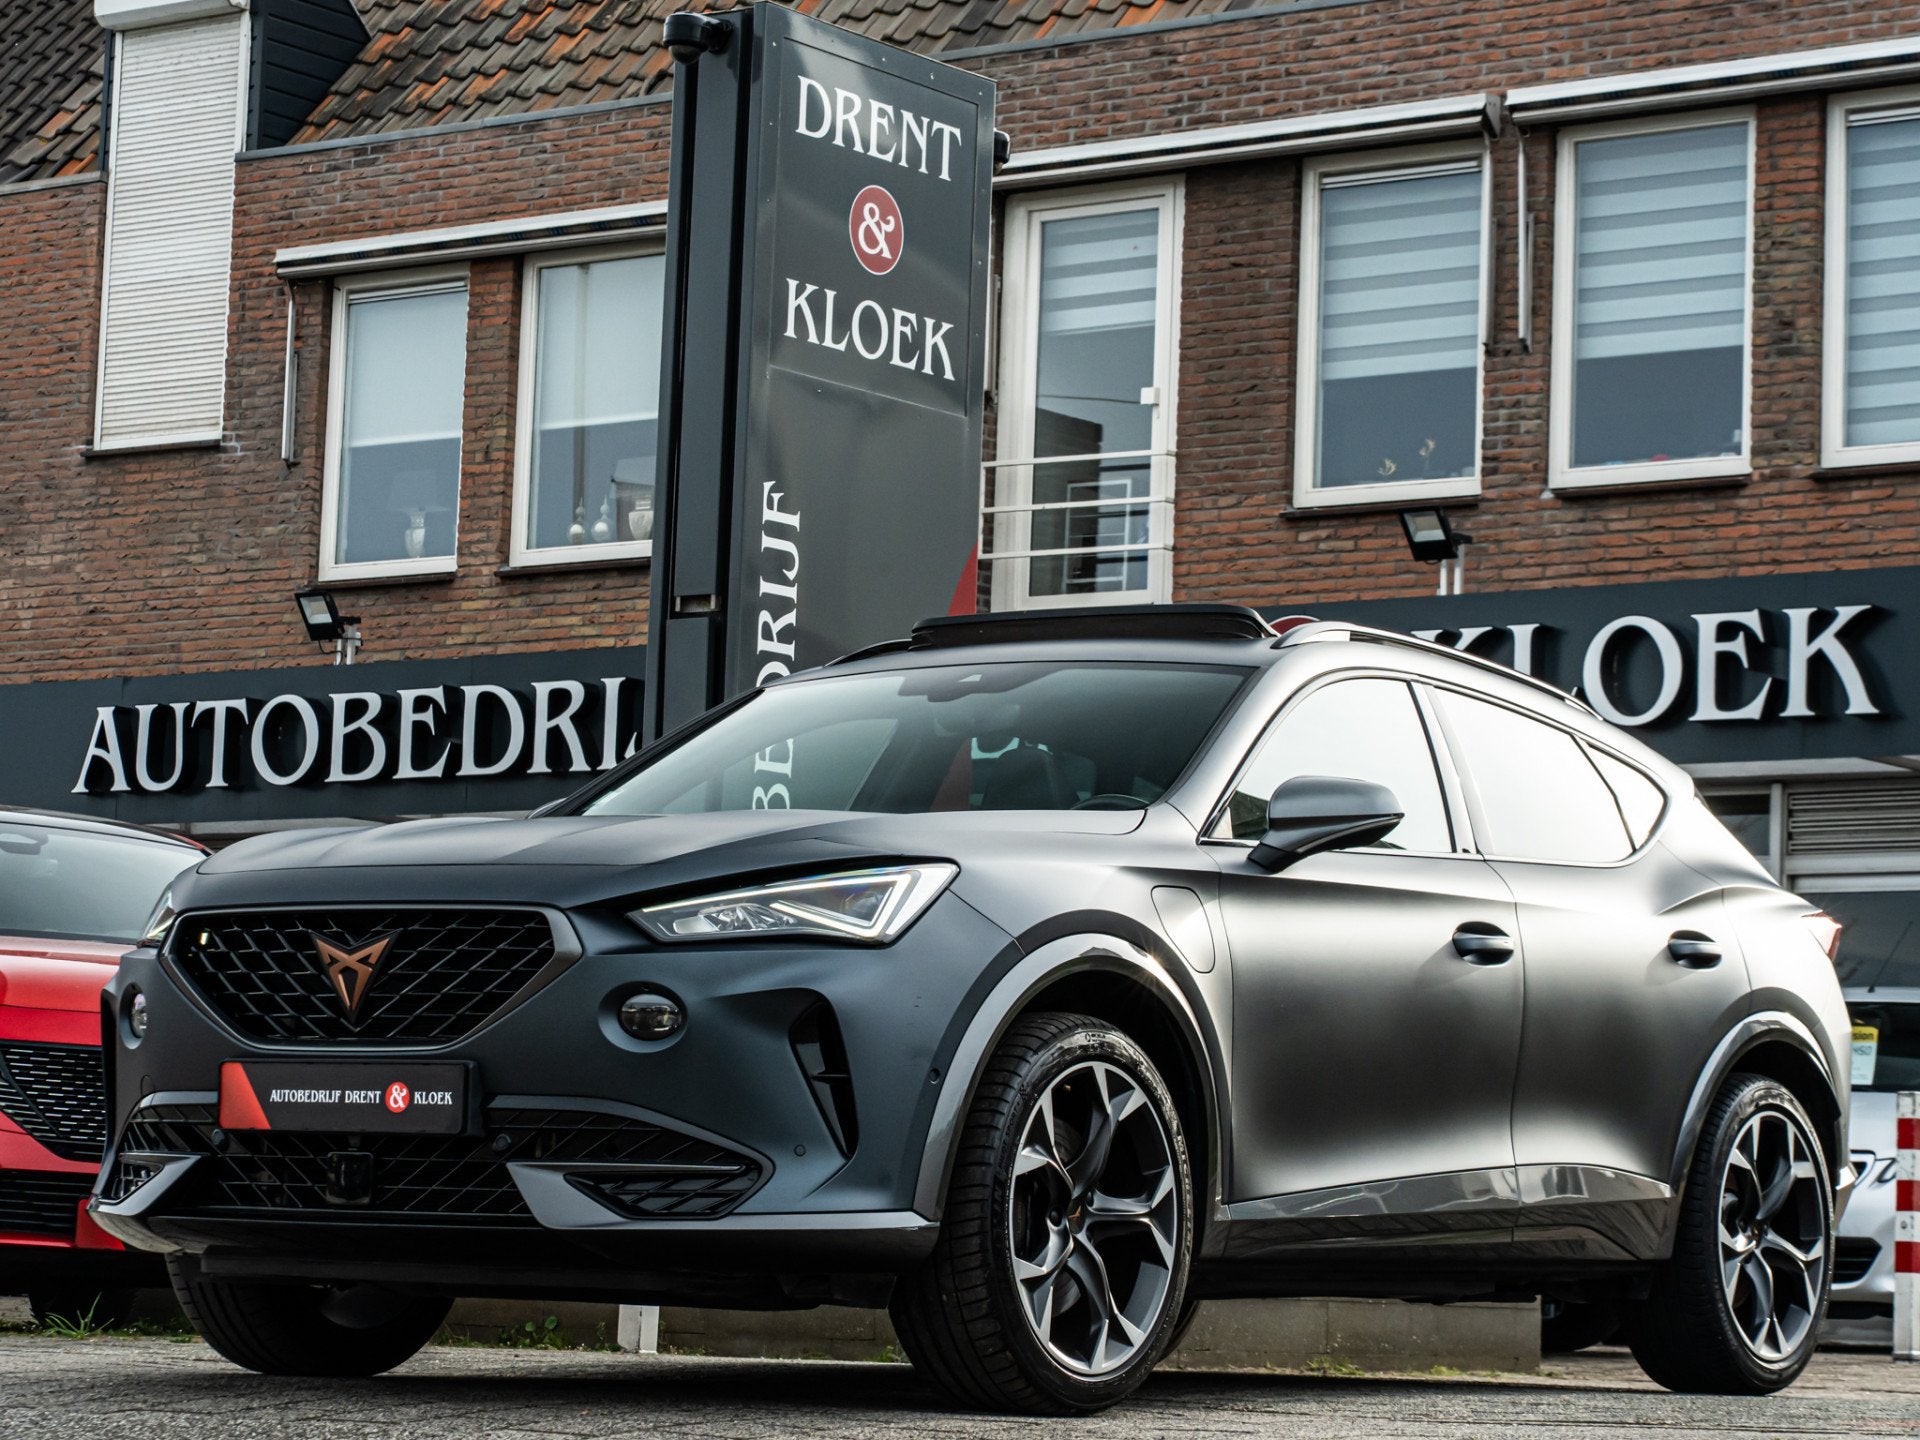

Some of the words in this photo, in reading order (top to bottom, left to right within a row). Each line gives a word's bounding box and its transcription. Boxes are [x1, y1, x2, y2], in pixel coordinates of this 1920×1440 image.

[795, 75, 962, 182] DRENT
[858, 202, 895, 260] &
[783, 278, 956, 381] KLOEK
[71, 677, 637, 794] AUTOBEDRI
[270, 1089, 341, 1104] AUTOBEDRIJF
[344, 1090, 382, 1104] DRENT
[389, 1085, 407, 1108] &
[414, 1091, 453, 1105] KLOEK
